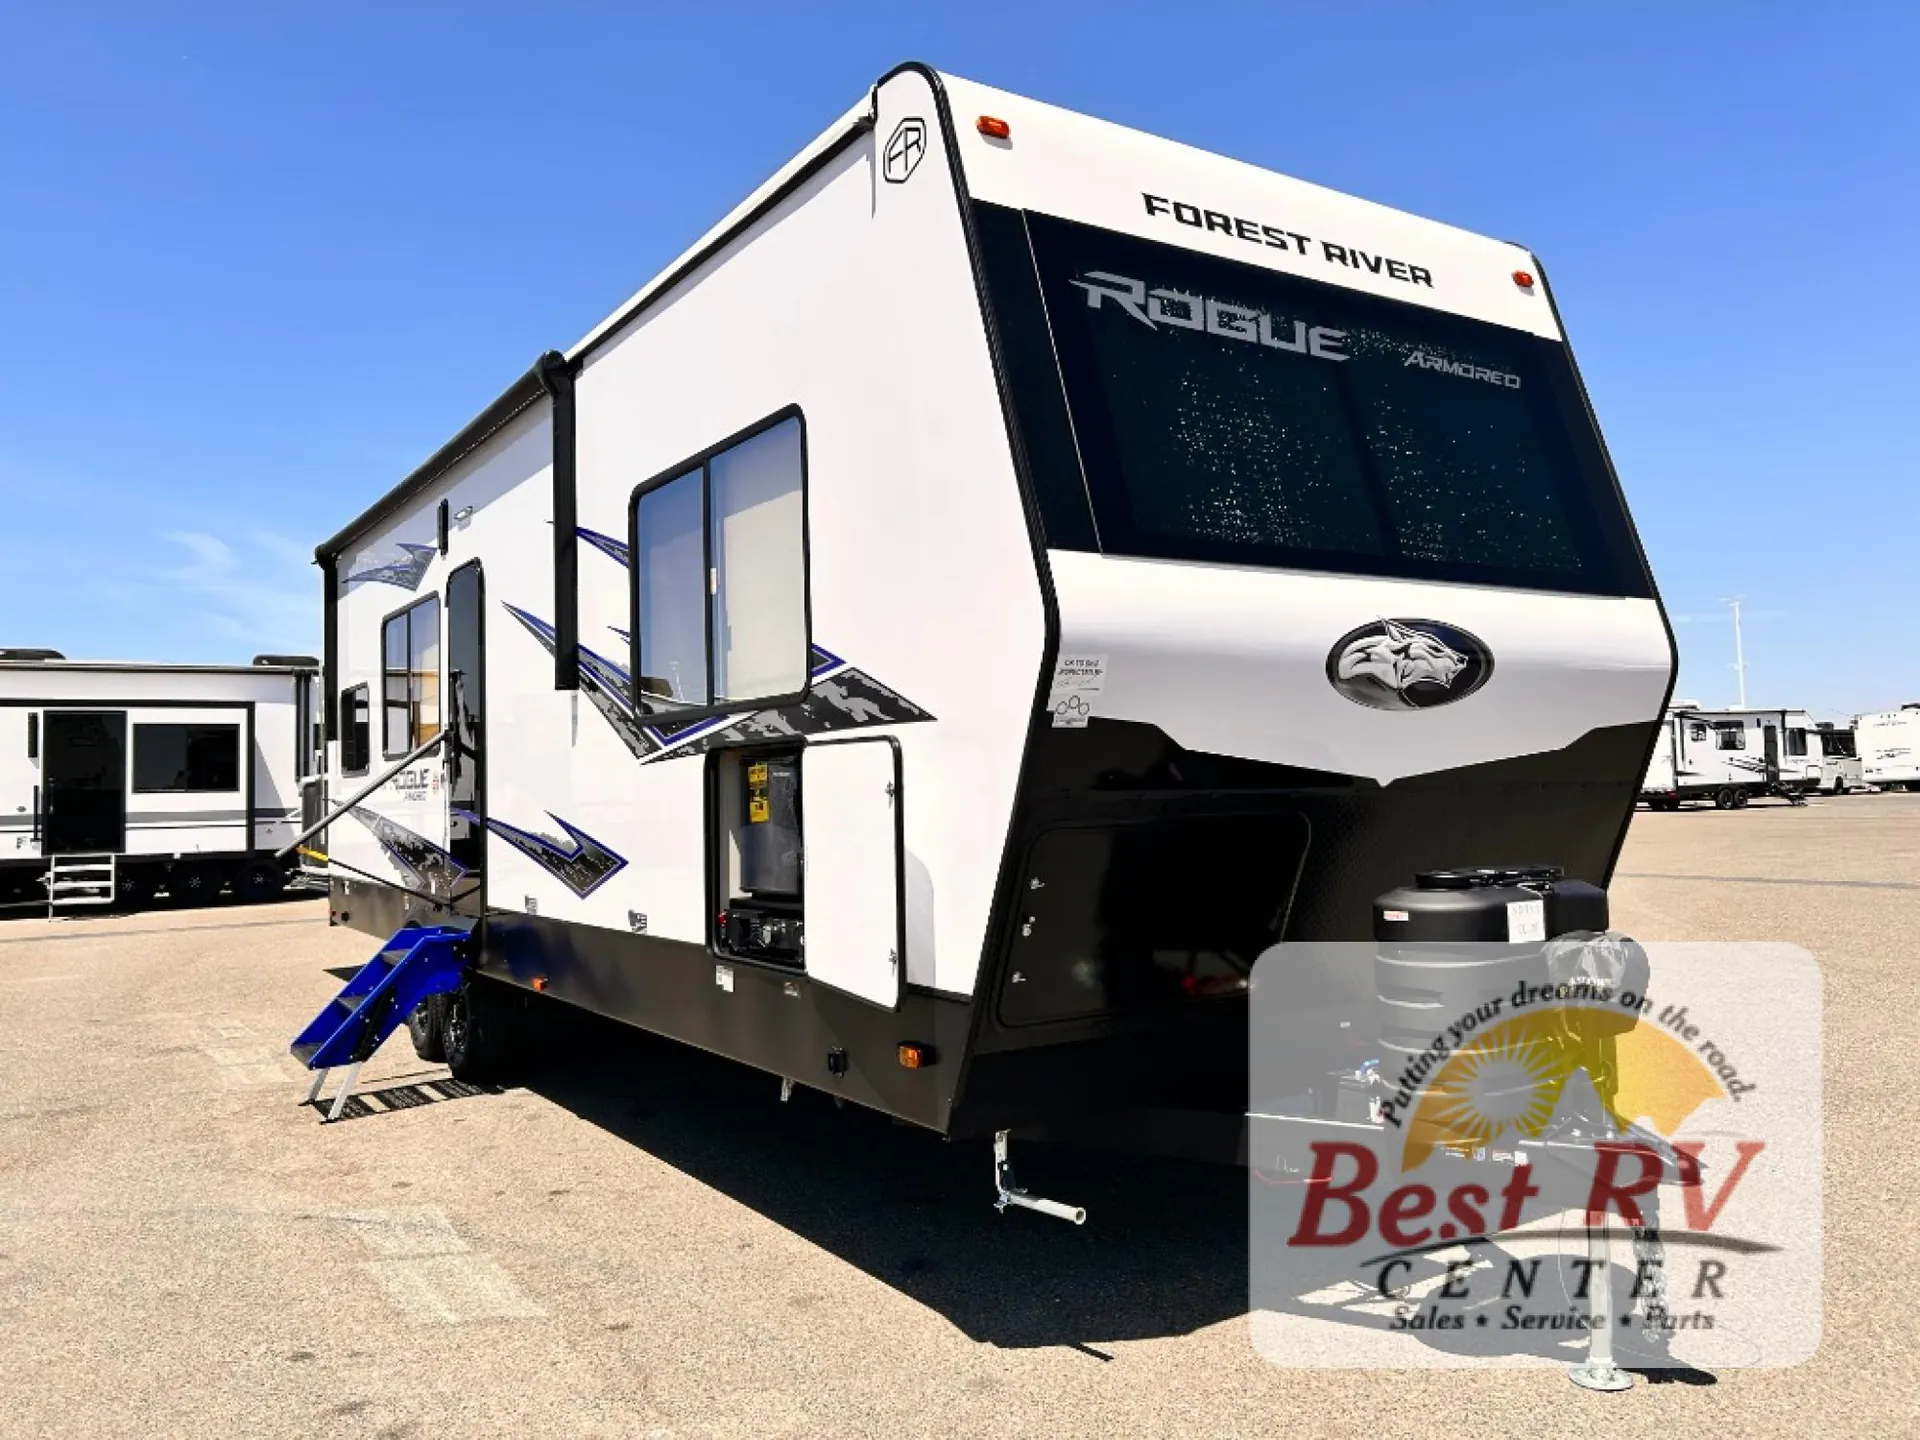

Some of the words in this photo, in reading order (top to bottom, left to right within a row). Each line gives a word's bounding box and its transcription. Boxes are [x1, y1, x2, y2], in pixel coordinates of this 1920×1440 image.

[1142, 192, 1311, 255] FOREST
[1320, 240, 1434, 289] RIVER
[1068, 271, 1350, 361] ROGUE
[1404, 350, 1521, 389] ARMORED
